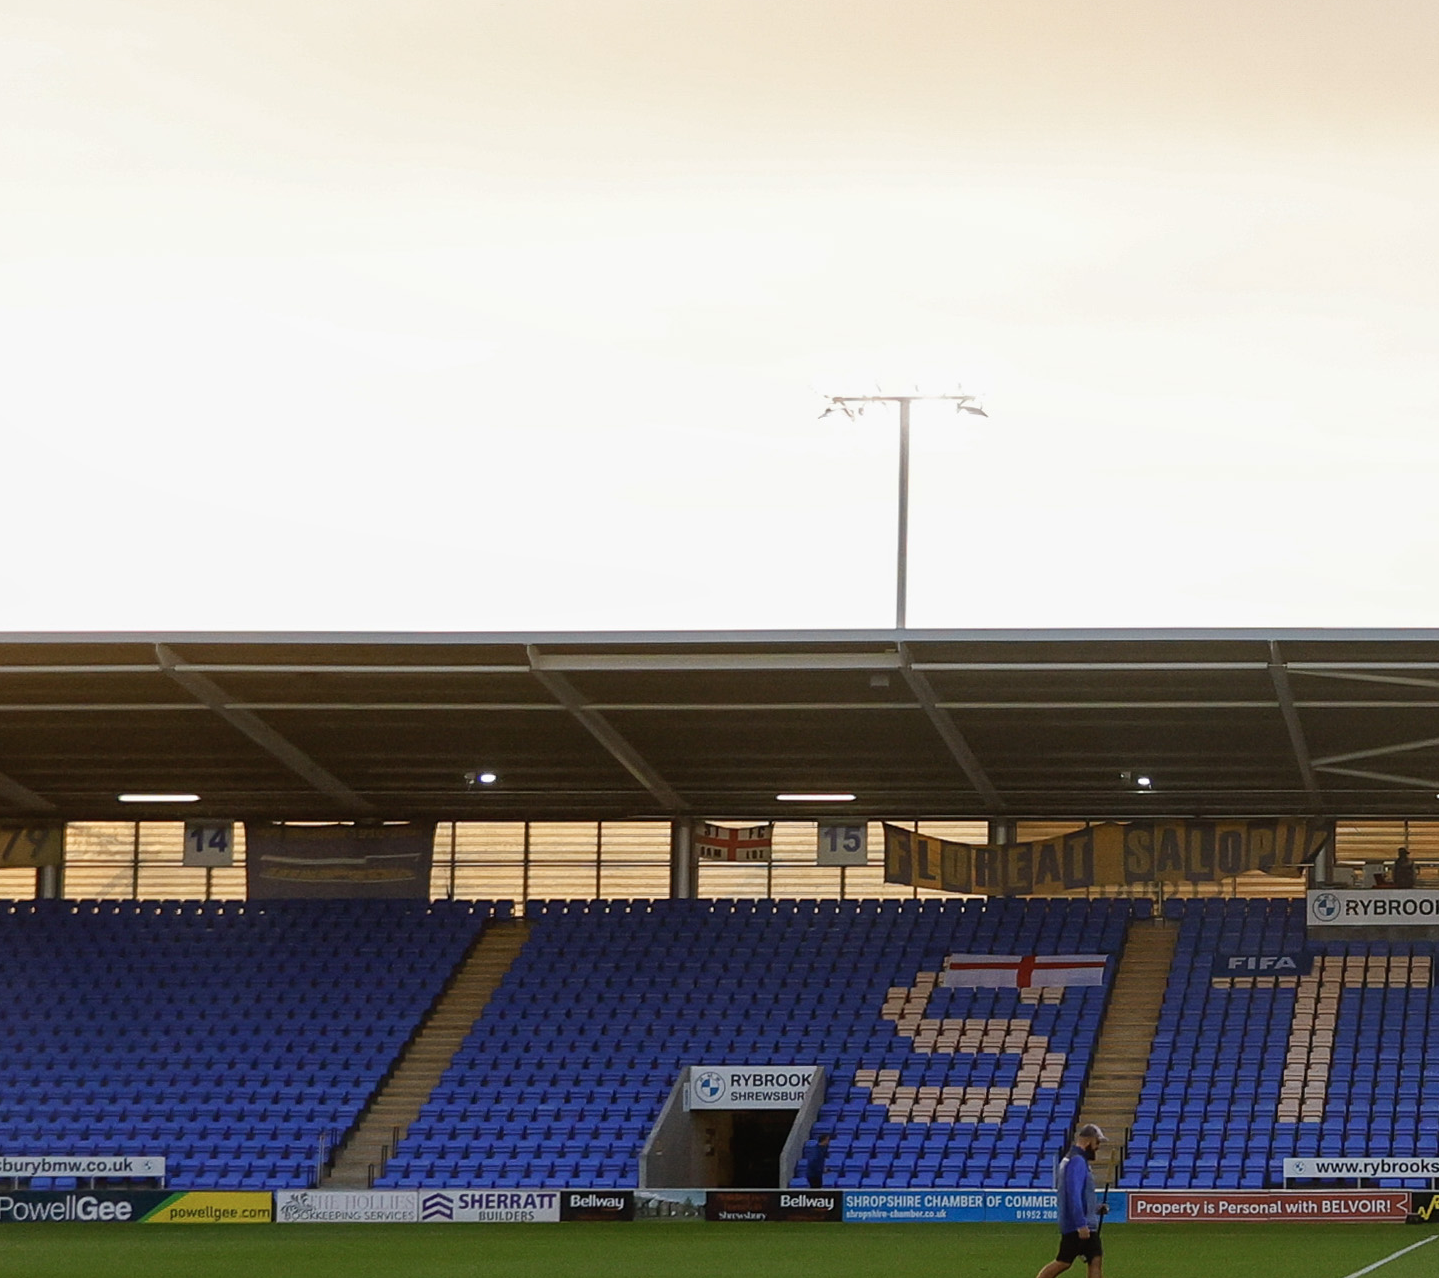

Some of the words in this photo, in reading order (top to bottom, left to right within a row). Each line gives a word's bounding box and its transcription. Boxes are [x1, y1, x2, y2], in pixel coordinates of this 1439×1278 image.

[190, 828, 228, 853] 14
[823, 826, 862, 853] 15
[888, 831, 1090, 891] FLOREAT
[1227, 956, 1297, 970] FIFA
[730, 1074, 812, 1088] RYBROOK
[730, 1091, 805, 1102] SHREWSBUR
[458, 1192, 558, 1210] SHERRATT
[570, 1193, 626, 1210] Bellway
[779, 1194, 835, 1211] Bellway
[845, 1195, 922, 1208] SHROPSHIRE
[924, 1195, 983, 1208] CHAMBER
[986, 1195, 1002, 1208] OF
[1004, 1195, 1058, 1208] COMMER
[1136, 1199, 1201, 1218] Property
[1203, 1200, 1215, 1215] is
[1218, 1198, 1282, 1214] Personal
[1286, 1198, 1318, 1214] with
[1321, 1199, 1392, 1214] BELVOIR!
[169, 1205, 270, 1221] powellgee.com
[365, 1210, 415, 1221] SERVICES
[479, 1210, 535, 1222] BUILDERS
[1016, 1210, 1042, 1220] 01952
